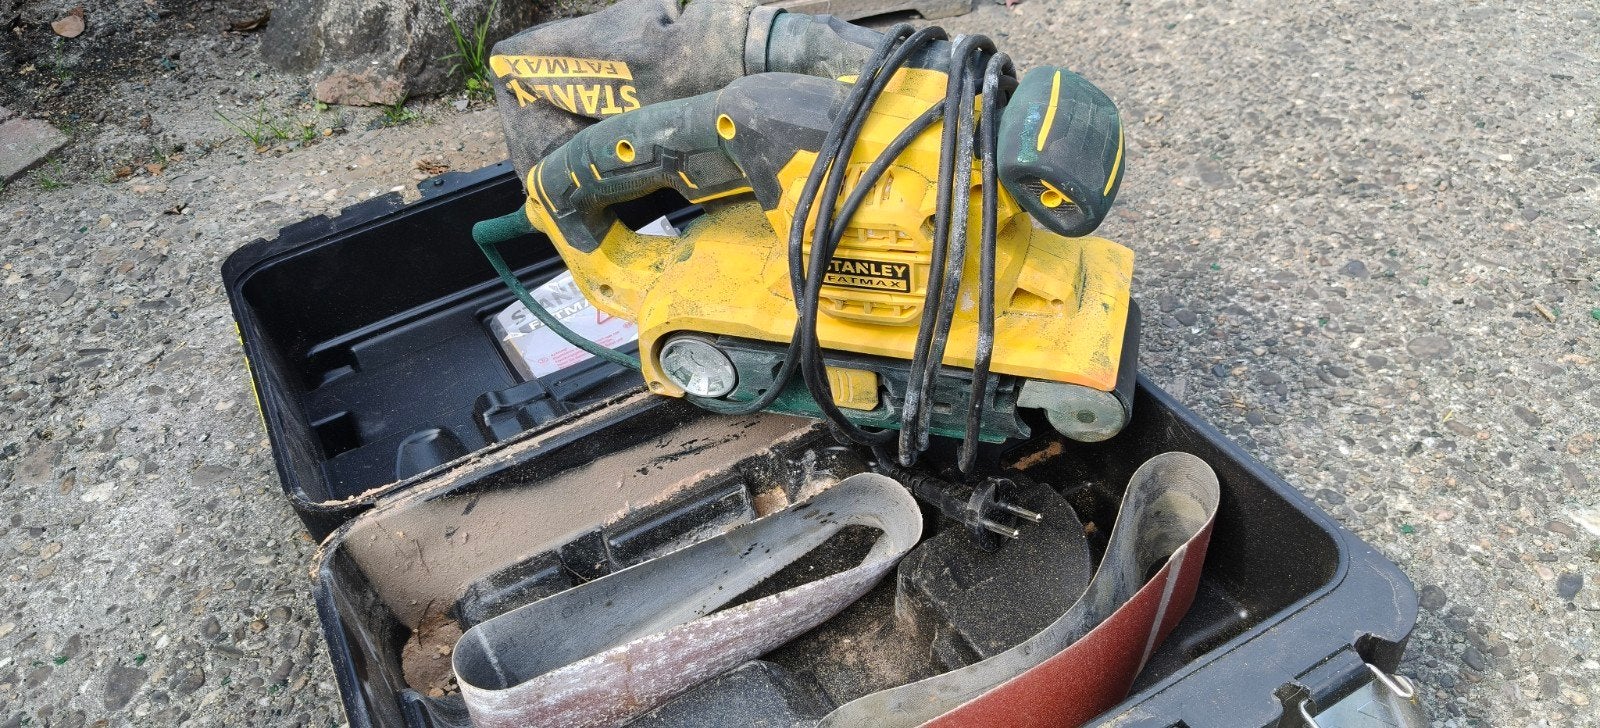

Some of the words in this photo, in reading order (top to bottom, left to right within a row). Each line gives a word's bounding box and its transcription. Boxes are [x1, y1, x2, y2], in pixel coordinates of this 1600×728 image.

[503, 58, 618, 75] FATMAX
[507, 78, 641, 115] STANLY
[828, 275, 900, 288] FATMAX
